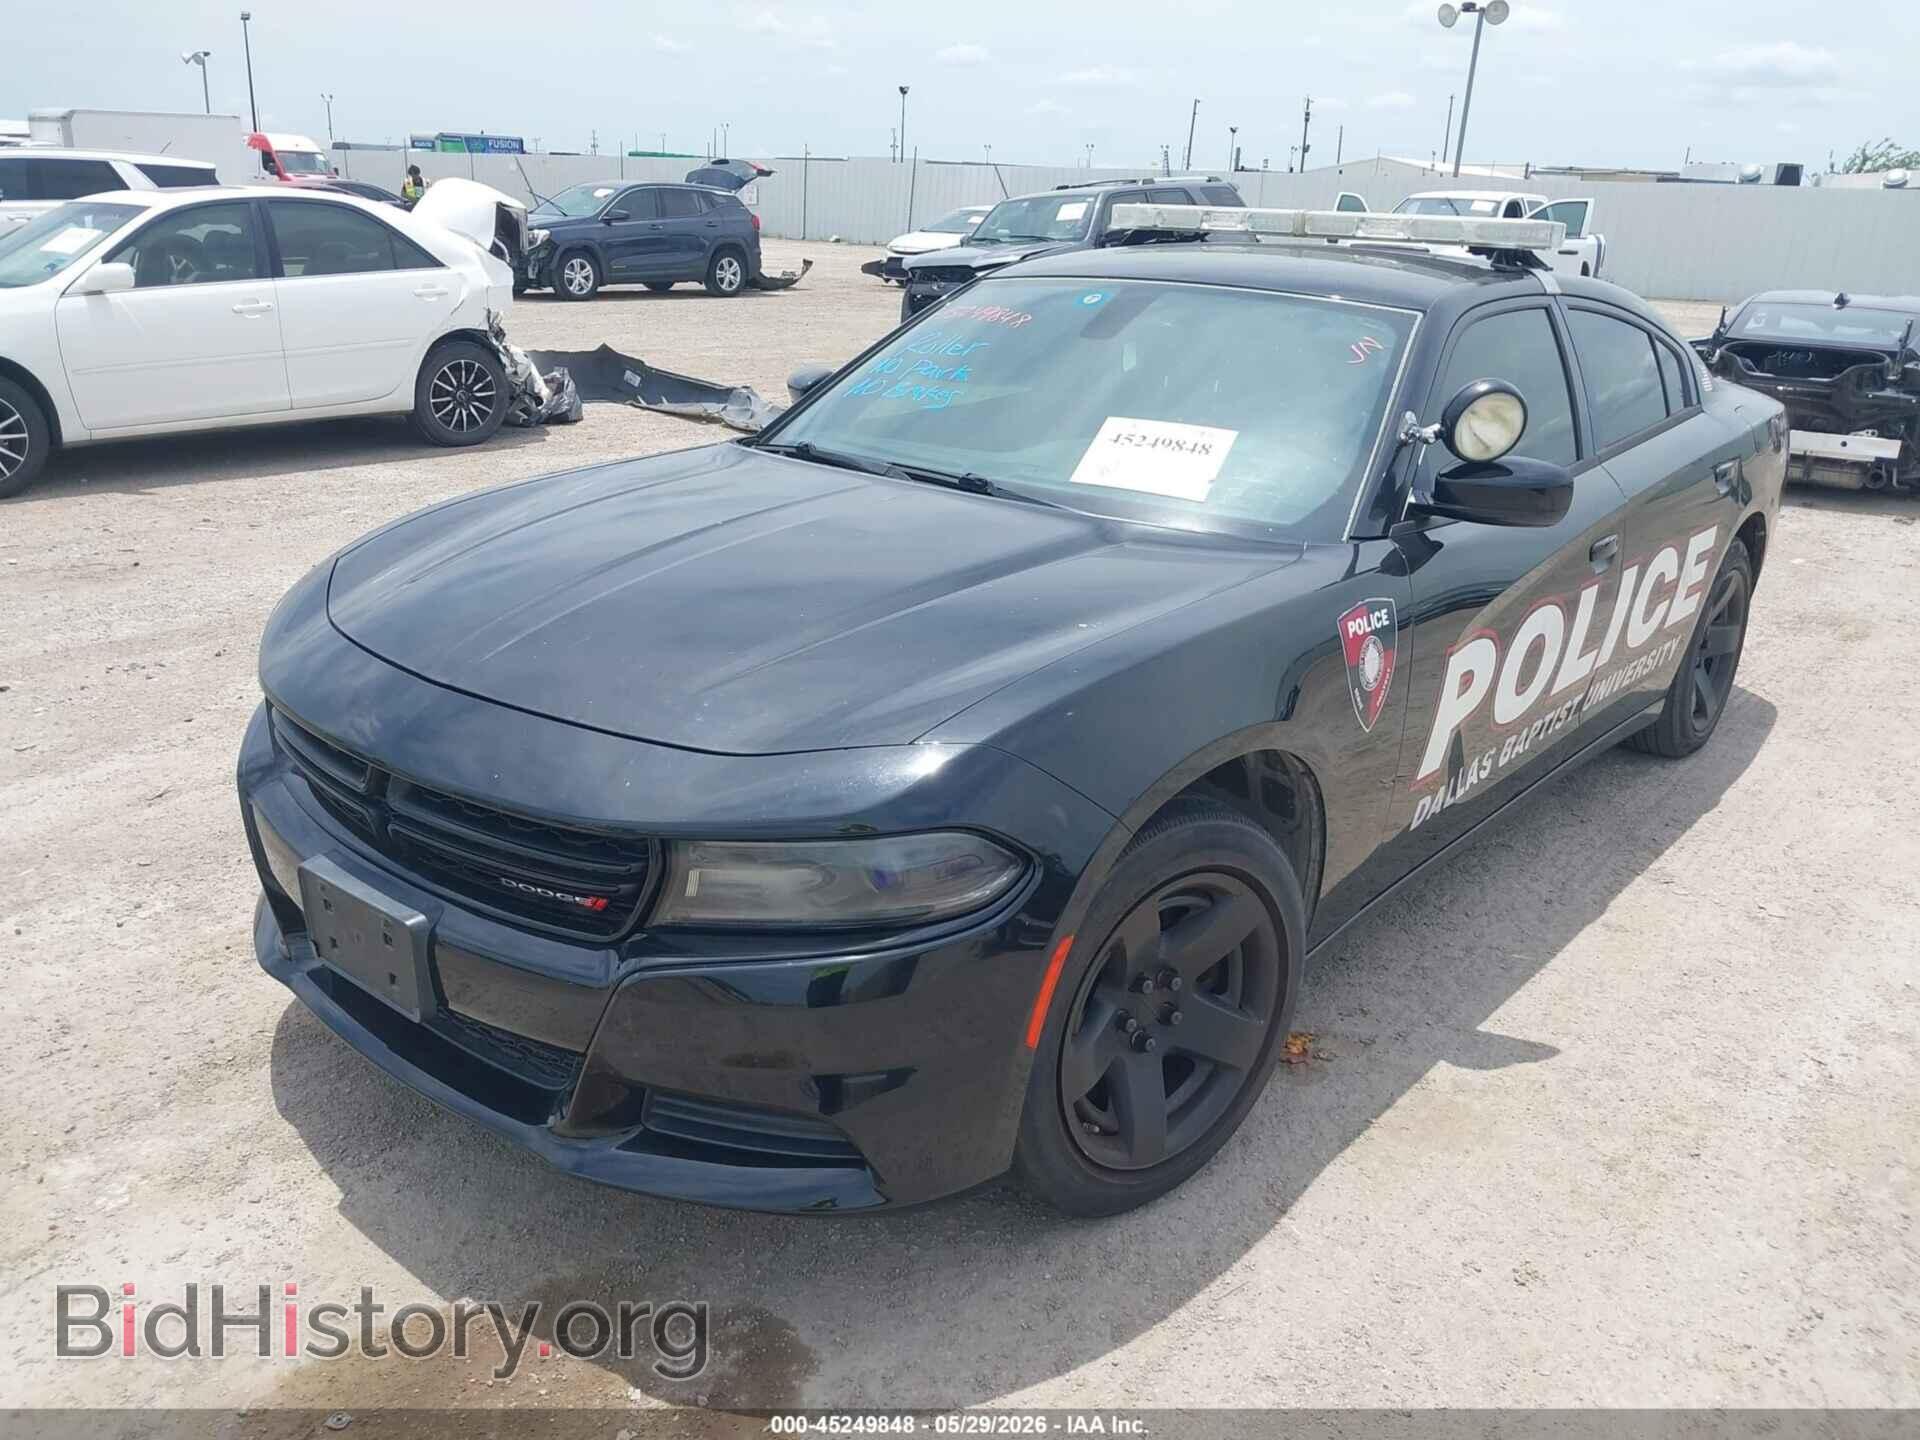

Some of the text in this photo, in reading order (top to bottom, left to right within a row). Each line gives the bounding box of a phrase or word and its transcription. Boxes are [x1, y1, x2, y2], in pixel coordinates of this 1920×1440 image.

[1109, 432, 1212, 456] 45249848
[1347, 608, 1390, 639] POLICE
[1415, 525, 1718, 781] POLICE
[1410, 634, 1682, 831] DALLAS BAPTIST UNIVERSITY
[501, 878, 593, 906] DODGE
